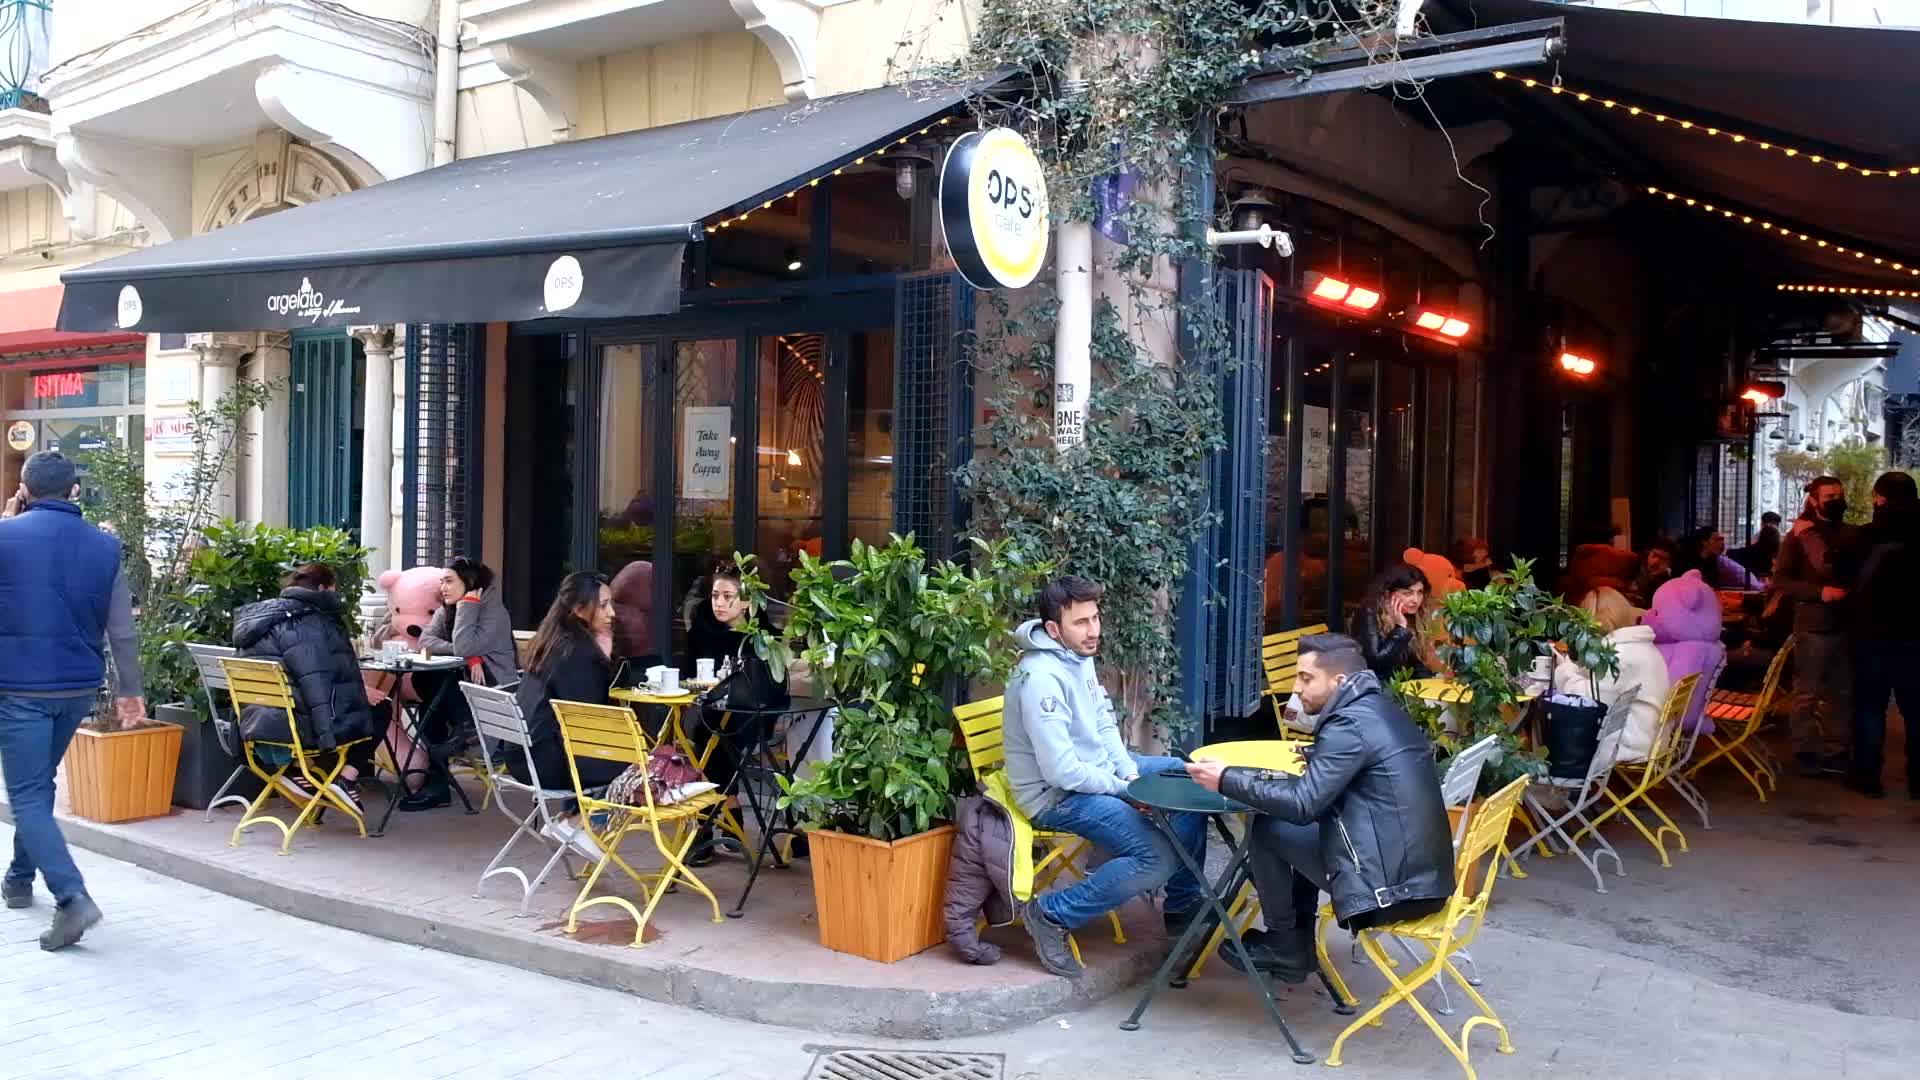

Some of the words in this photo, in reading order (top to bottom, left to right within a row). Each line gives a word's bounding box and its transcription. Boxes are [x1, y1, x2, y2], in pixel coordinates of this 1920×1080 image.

[554, 276, 575, 289] OPS
[267, 288, 324, 315] argelato
[1057, 410, 1081, 426] BNE
[696, 430, 719, 442] Take
[1057, 426, 1081, 435] WAS
[1057, 436, 1081, 445] HERE
[695, 446, 721, 460] Away
[692, 462, 722, 477] Coffee
